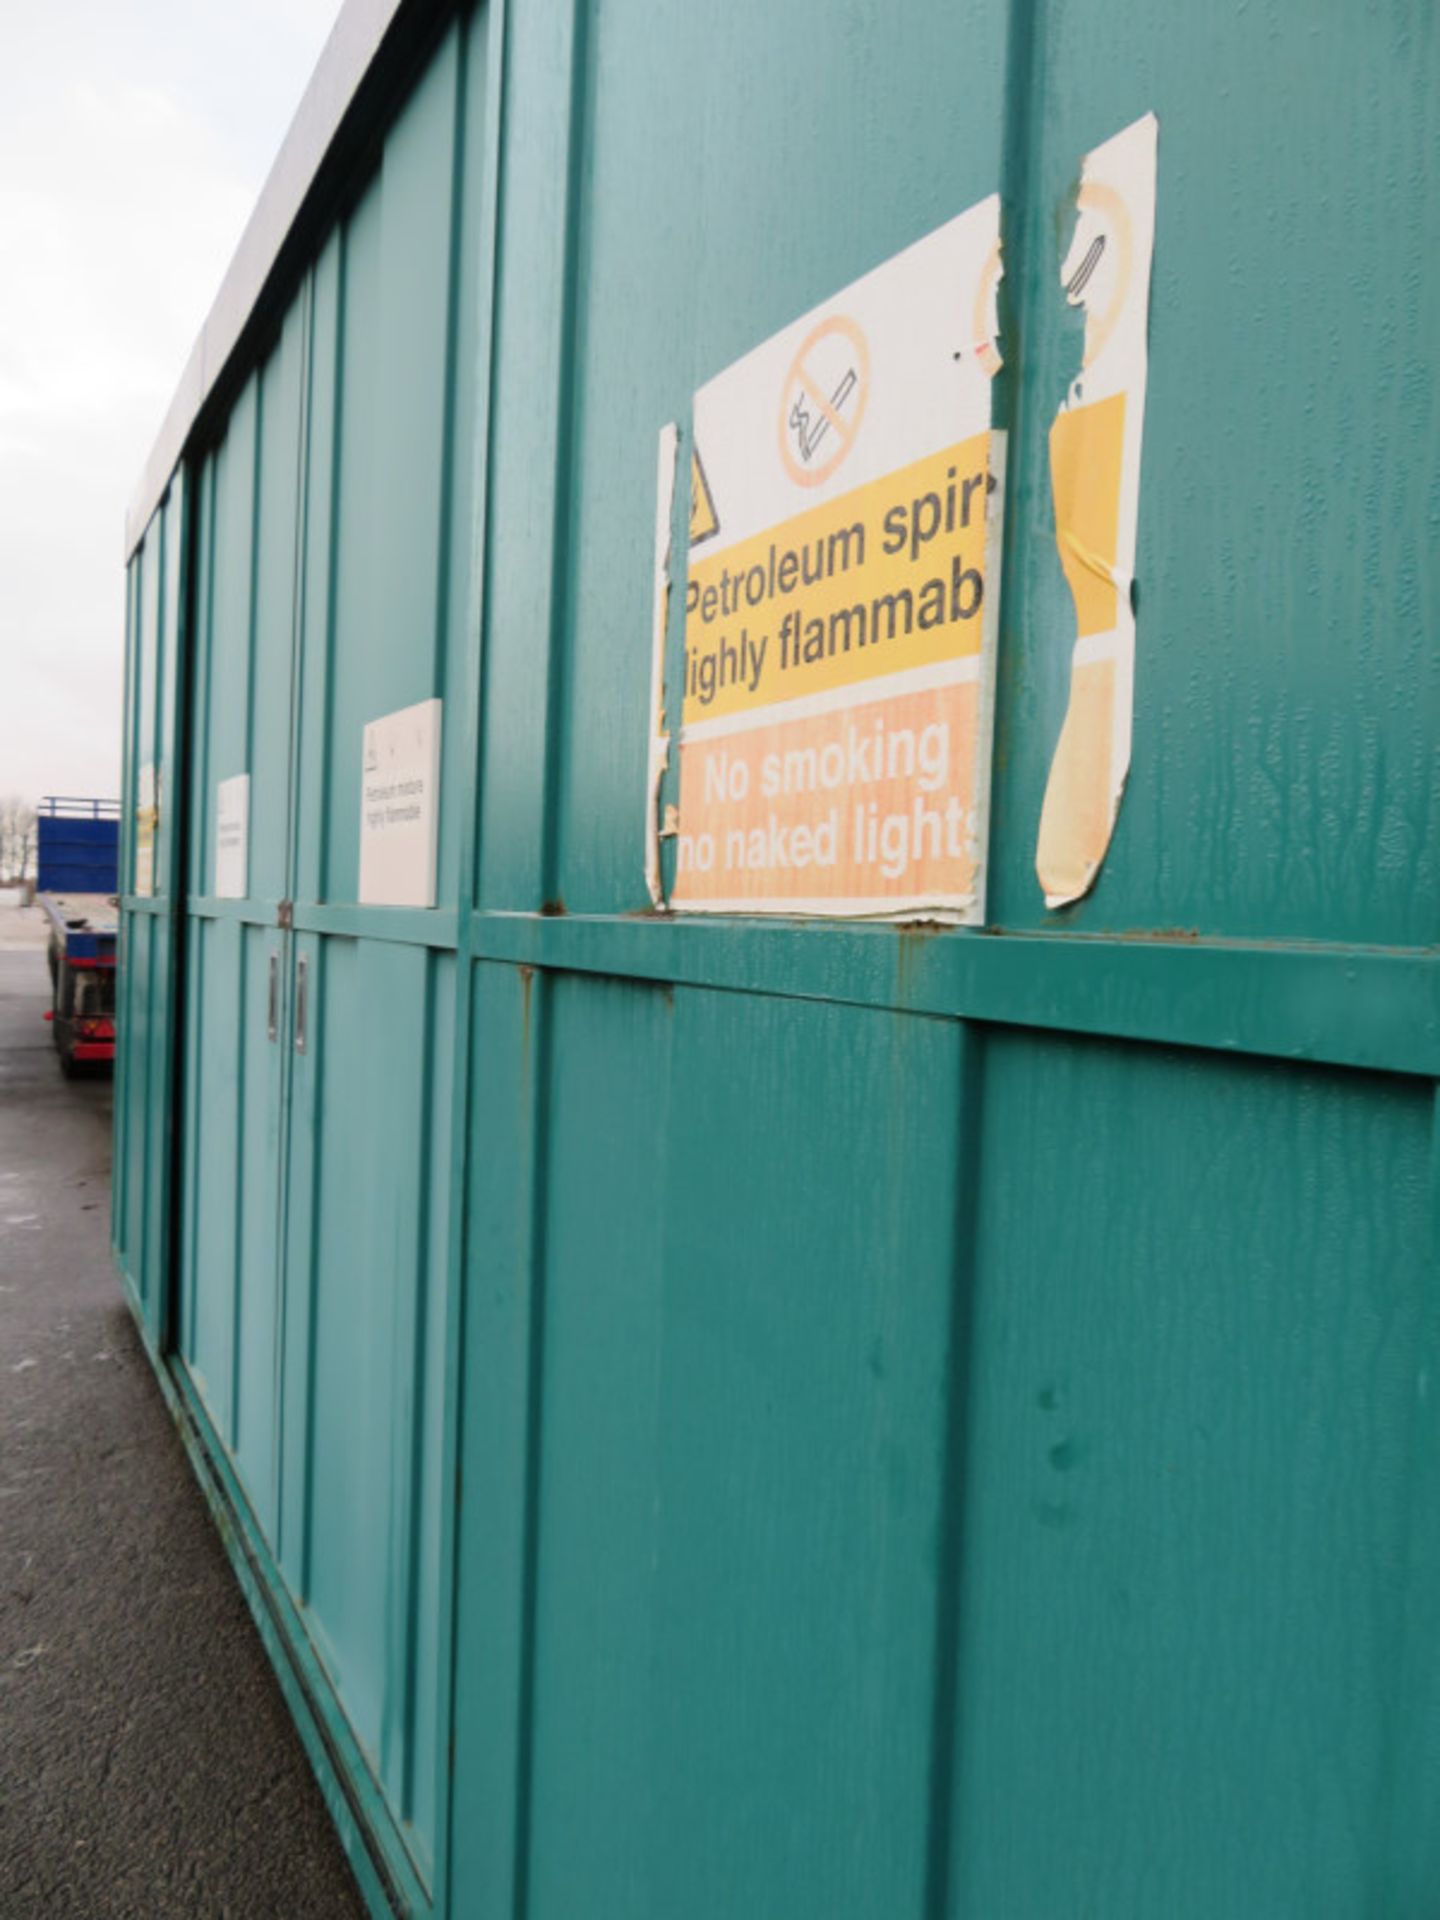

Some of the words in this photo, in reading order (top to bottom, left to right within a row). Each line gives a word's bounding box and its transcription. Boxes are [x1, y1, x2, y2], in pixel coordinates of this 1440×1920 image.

[882, 464, 990, 562] spir
[682, 628, 769, 706] ighly
[704, 751, 750, 807] No
[760, 718, 949, 798] smoking
[677, 831, 714, 872] no
[725, 806, 837, 870] naked
